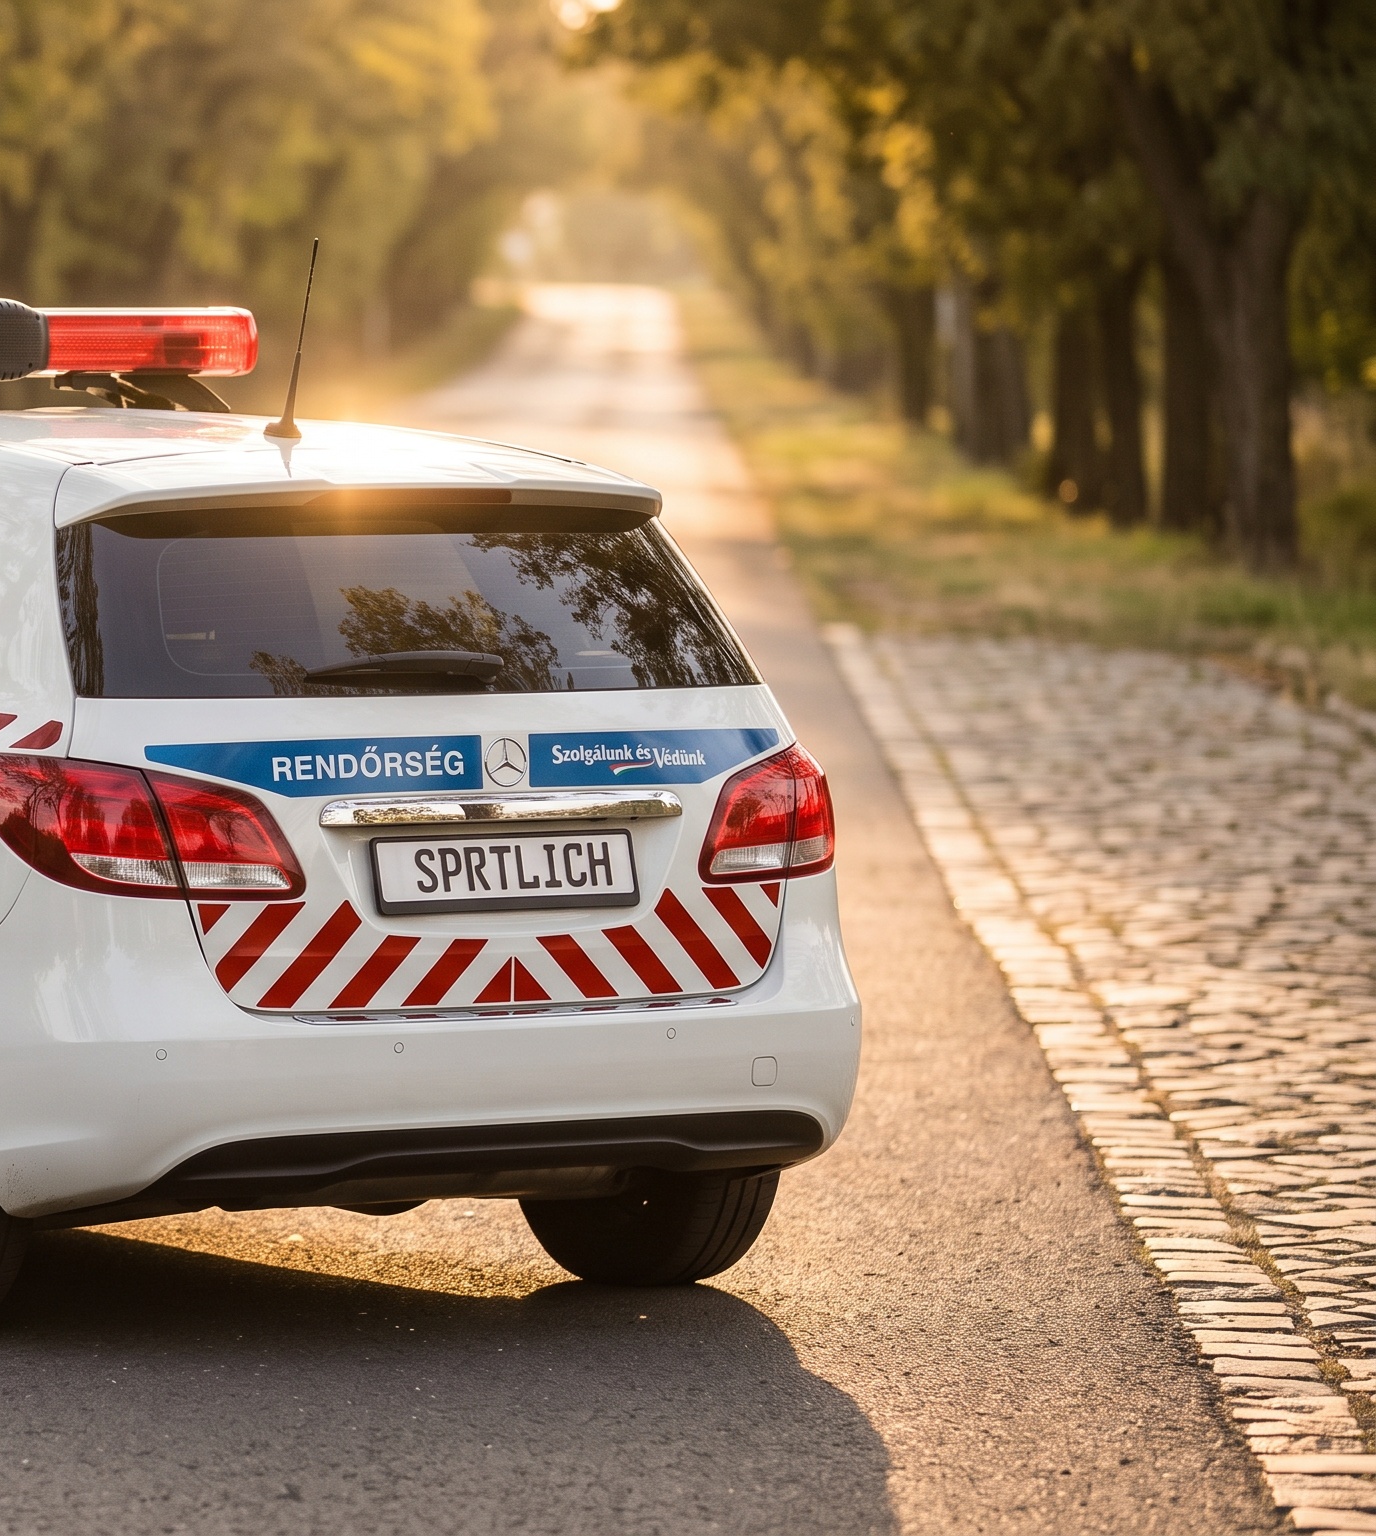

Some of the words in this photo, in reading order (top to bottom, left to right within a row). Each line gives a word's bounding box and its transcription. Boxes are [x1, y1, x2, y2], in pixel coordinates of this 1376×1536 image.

[272, 744, 465, 782] RENDŐRSÉG
[551, 740, 634, 766] Szolgálunk
[635, 743, 652, 760] és
[652, 747, 707, 769] Védünk
[414, 841, 614, 893] SPRTLICH
